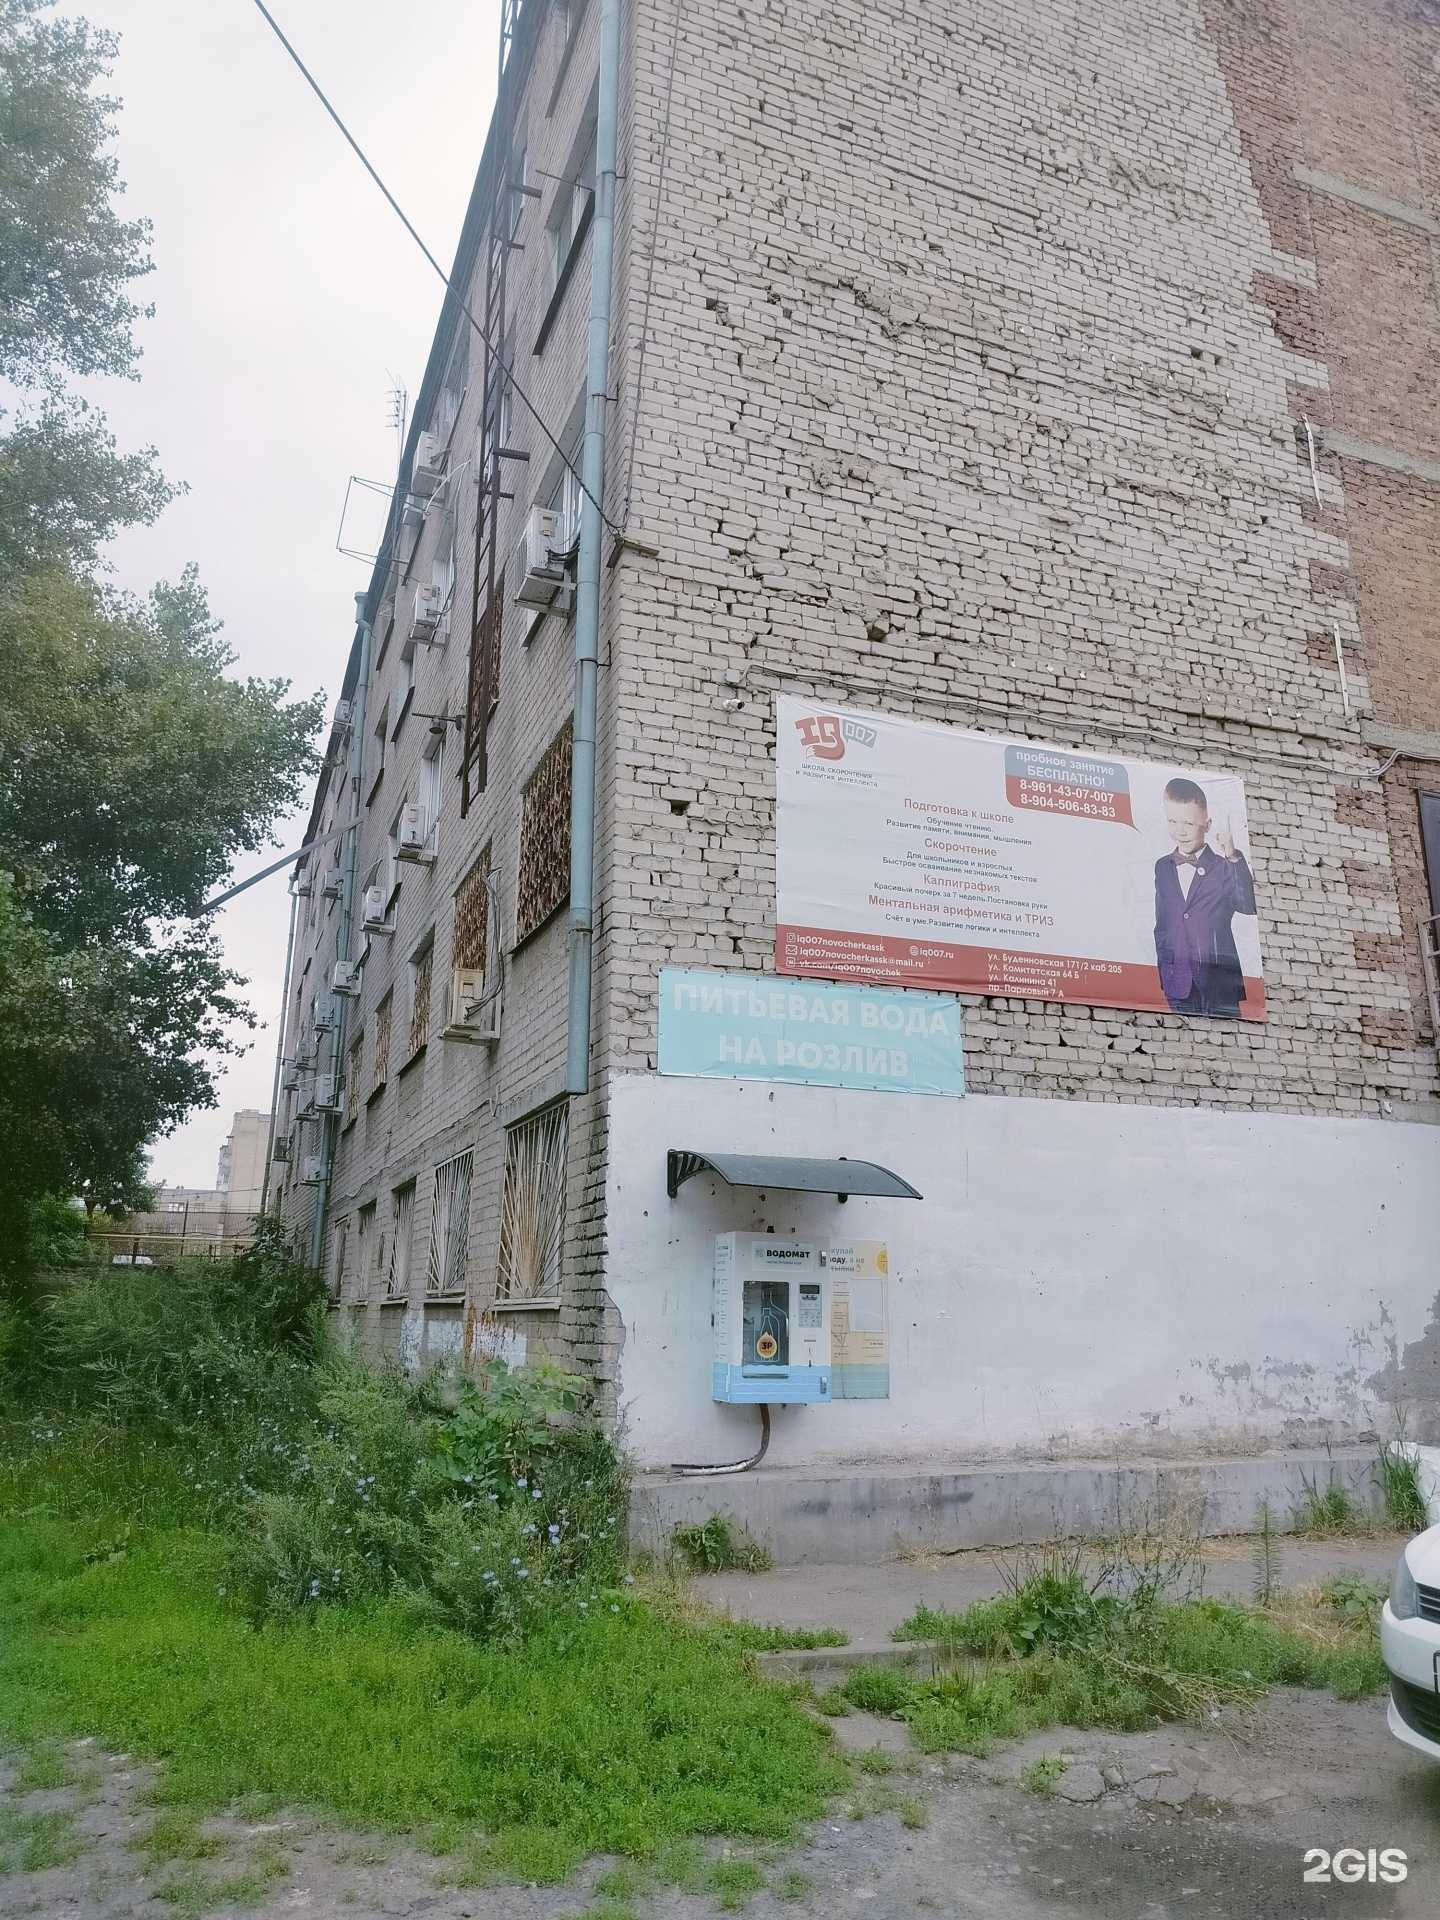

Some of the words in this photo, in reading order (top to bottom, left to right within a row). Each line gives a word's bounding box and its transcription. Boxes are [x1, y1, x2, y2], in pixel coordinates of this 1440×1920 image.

[1016, 752, 1067, 767] пробное
[1069, 760, 1114, 776] занятие
[1027, 765, 1105, 787] БЕСПЛАТНО!
[1020, 779, 1114, 804] 8-961-43-07-007
[904, 798, 968, 817] Подготовка
[971, 810, 977, 818] к
[980, 811, 1015, 824] школе
[1020, 793, 1116, 818] 8-904-506-83-83
[886, 818, 921, 830] Развитие
[993, 834, 1032, 846] мышления
[926, 816, 963, 828] Обучение
[906, 851, 921, 860] Для
[923, 853, 969, 866] школьников
[924, 838, 997, 857] Скорочтение
[882, 856, 917, 868] Быстрое
[964, 868, 1008, 880] незнакомых
[1009, 874, 1037, 884] текстов
[923, 873, 1000, 895] Каллиграфия
[873, 881, 913, 894] Красивый
[914, 888, 941, 899] почерк
[942, 891, 951, 899] за
[1031, 902, 1048, 911] руки
[868, 894, 940, 913] Ментальная
[943, 903, 1012, 922] арифметика
[1015, 914, 1022, 923] и
[1025, 913, 1054, 927] ТРИЗ
[965, 923, 991, 934] логики
[998, 927, 1040, 938] интеллекта
[919, 947, 954, 959] iq007.ru
[987, 952, 1000, 961] ул.
[1002, 953, 1064, 968] Буденновская
[1066, 959, 1089, 971] 171/2
[1090, 962, 1106, 972] каб
[1108, 964, 1122, 974] 205
[987, 963, 1000, 972] ул.
[1002, 964, 1061, 977] Комитетская
[1062, 970, 1073, 978] 64
[988, 974, 1001, 982] ул.
[1003, 974, 1046, 986] Калинина
[1047, 978, 1057, 986] 41
[988, 984, 1002, 993] пр.
[1004, 984, 1049, 997] Парковый
[673, 983, 850, 1026] ПИТЬЕВАЯ
[859, 1001, 949, 1038] ВОДА
[719, 1034, 768, 1065] НА
[777, 1039, 909, 1078] РОЗЛИВ
[766, 1249, 811, 1259] водомат
[829, 1256, 848, 1265] оду,
